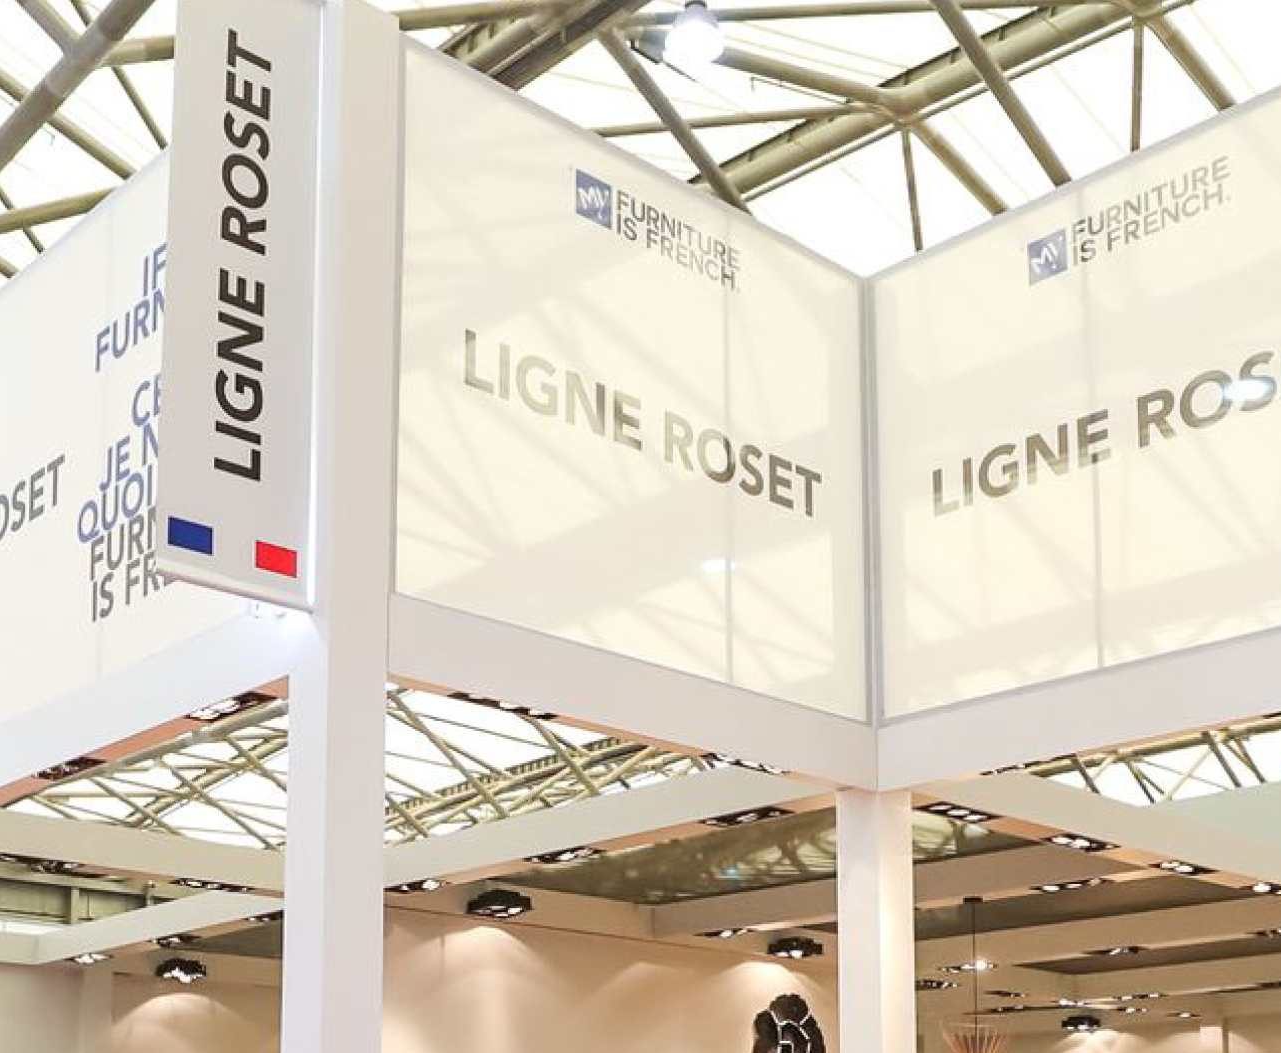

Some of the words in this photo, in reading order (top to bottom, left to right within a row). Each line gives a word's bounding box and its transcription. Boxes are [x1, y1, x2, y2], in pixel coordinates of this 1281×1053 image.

[220, 28, 274, 257] ROSET
[616, 213, 638, 241] IS
[616, 188, 740, 271] FURNITURE
[1071, 155, 1232, 245] FURNITURE
[1073, 239, 1097, 266] IS
[212, 268, 266, 483] LIGNE
[98, 434, 131, 492] JE
[463, 328, 642, 452] LIGNE
[663, 408, 823, 518] ROSET
[932, 408, 1112, 518] LIGNE
[91, 571, 114, 623] IS
